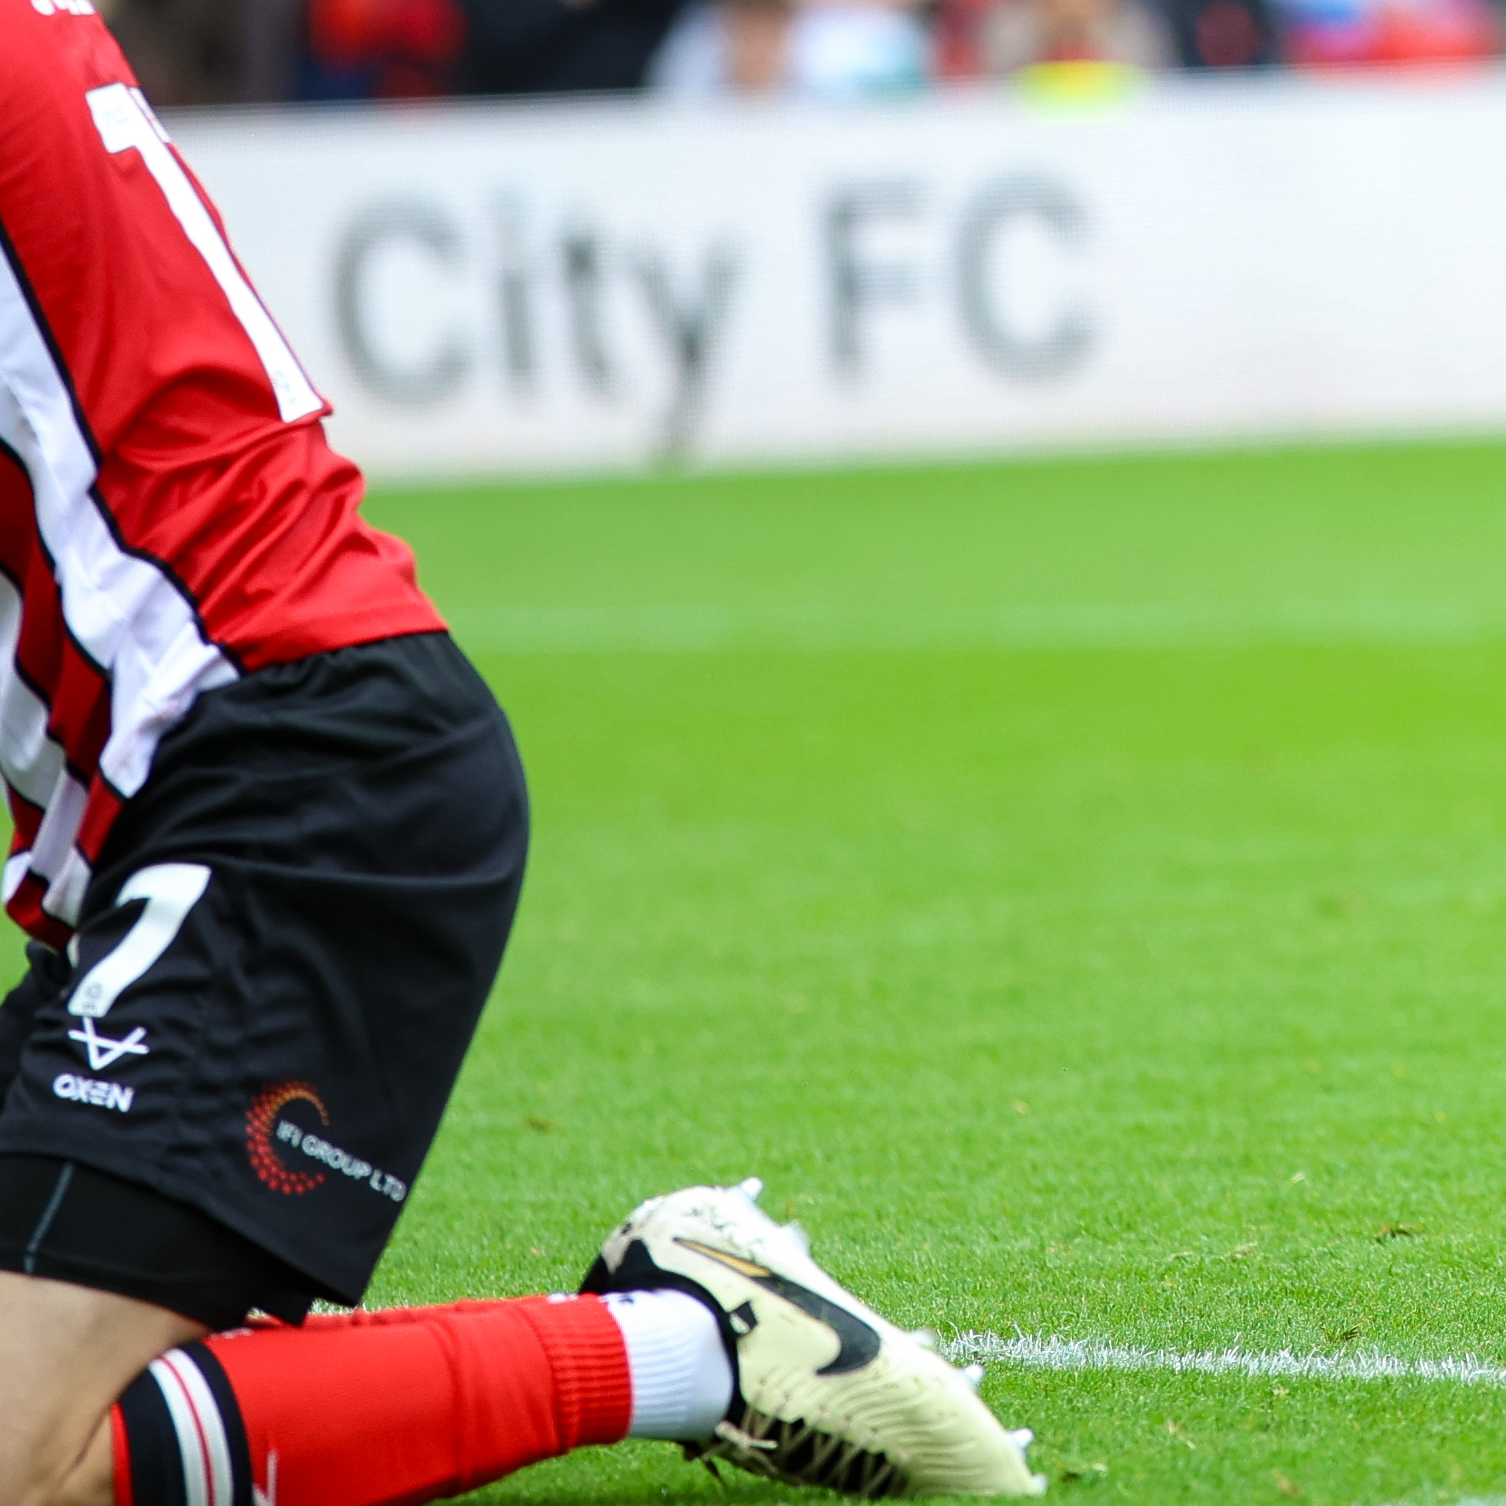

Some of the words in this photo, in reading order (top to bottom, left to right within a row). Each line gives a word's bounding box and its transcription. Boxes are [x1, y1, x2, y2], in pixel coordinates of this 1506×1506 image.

[84, 82, 324, 423] 1
[329, 184, 748, 469] City
[821, 168, 1100, 392] FC
[67, 863, 212, 1018] 7
[52, 1074, 135, 1112] OXEN
[301, 1134, 372, 1180] GROUP
[369, 1169, 407, 1202] LTD
